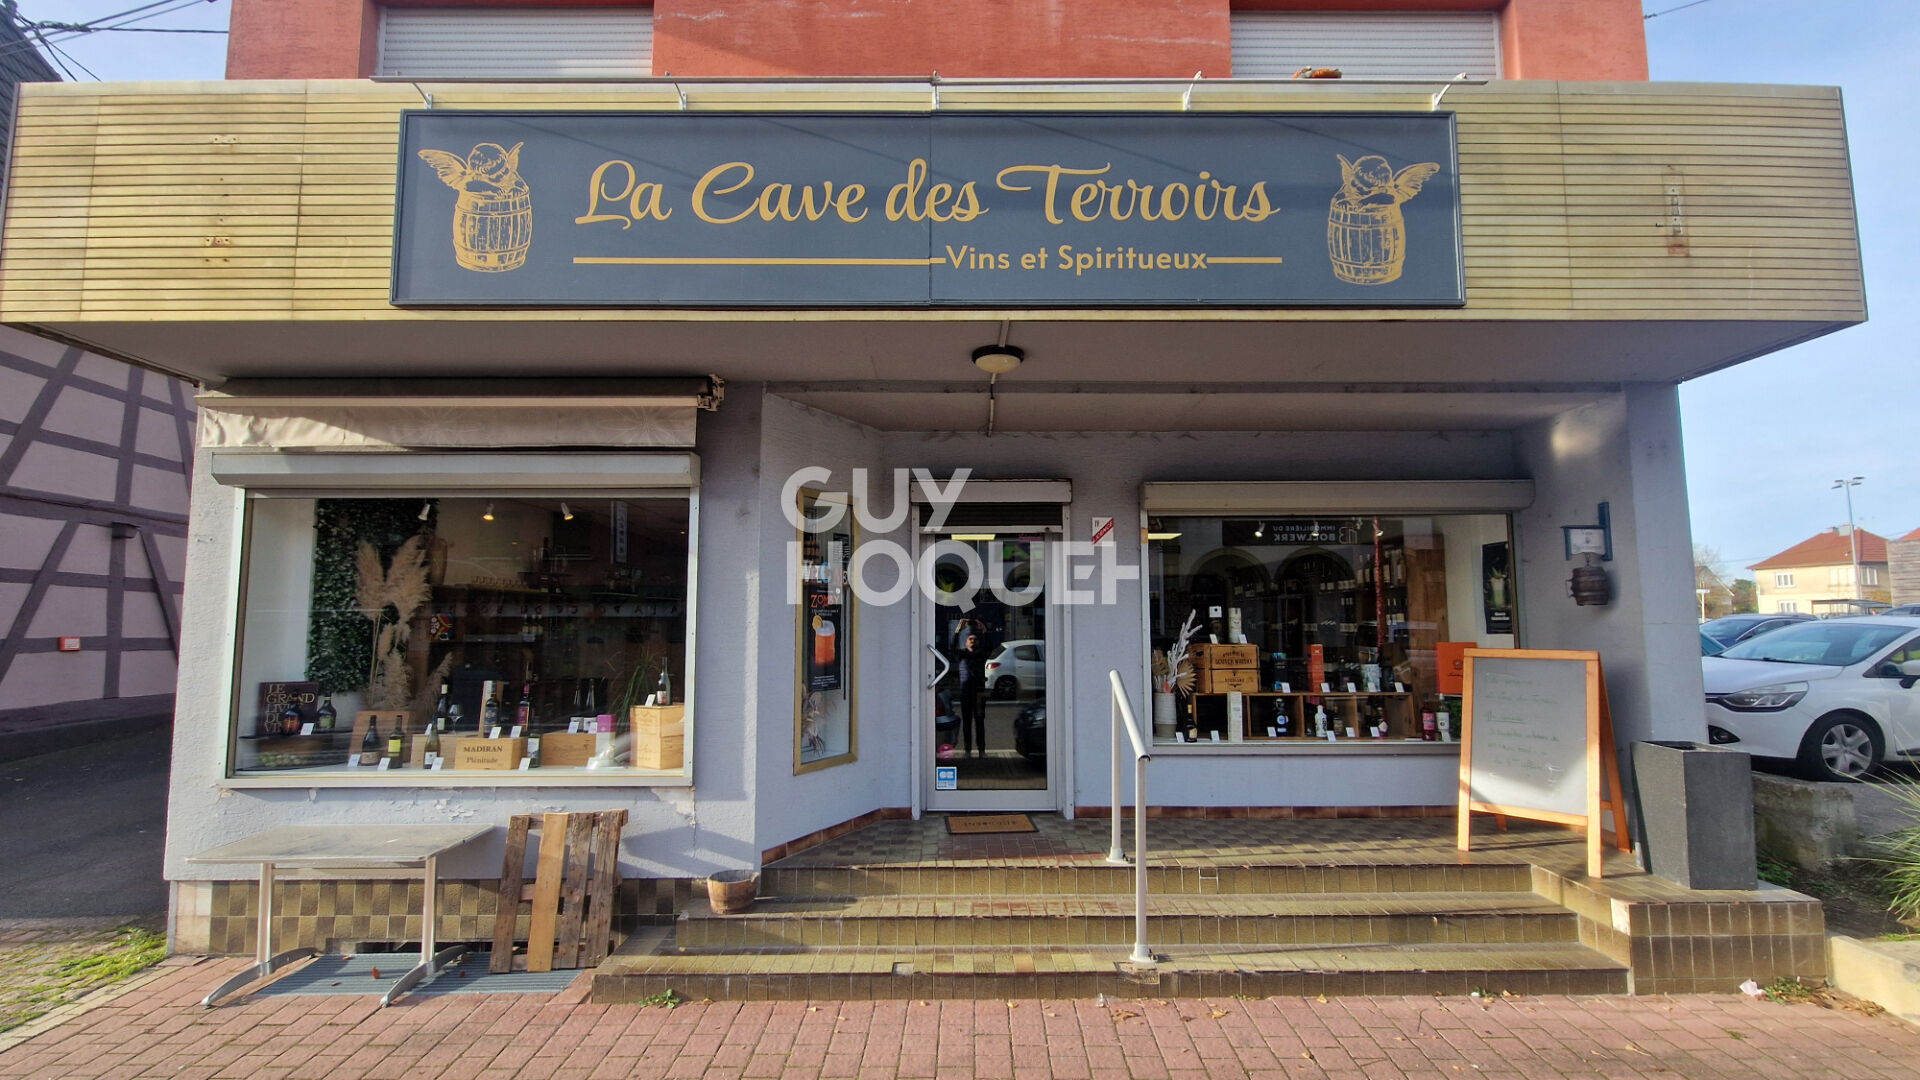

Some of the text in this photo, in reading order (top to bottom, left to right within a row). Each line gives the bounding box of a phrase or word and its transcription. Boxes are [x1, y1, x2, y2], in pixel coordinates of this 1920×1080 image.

[574, 158, 1281, 230] La Cave des Terroirs
[945, 245, 1208, 276] Vins et Spiritueux
[463, 745, 503, 753] MADIRAN
